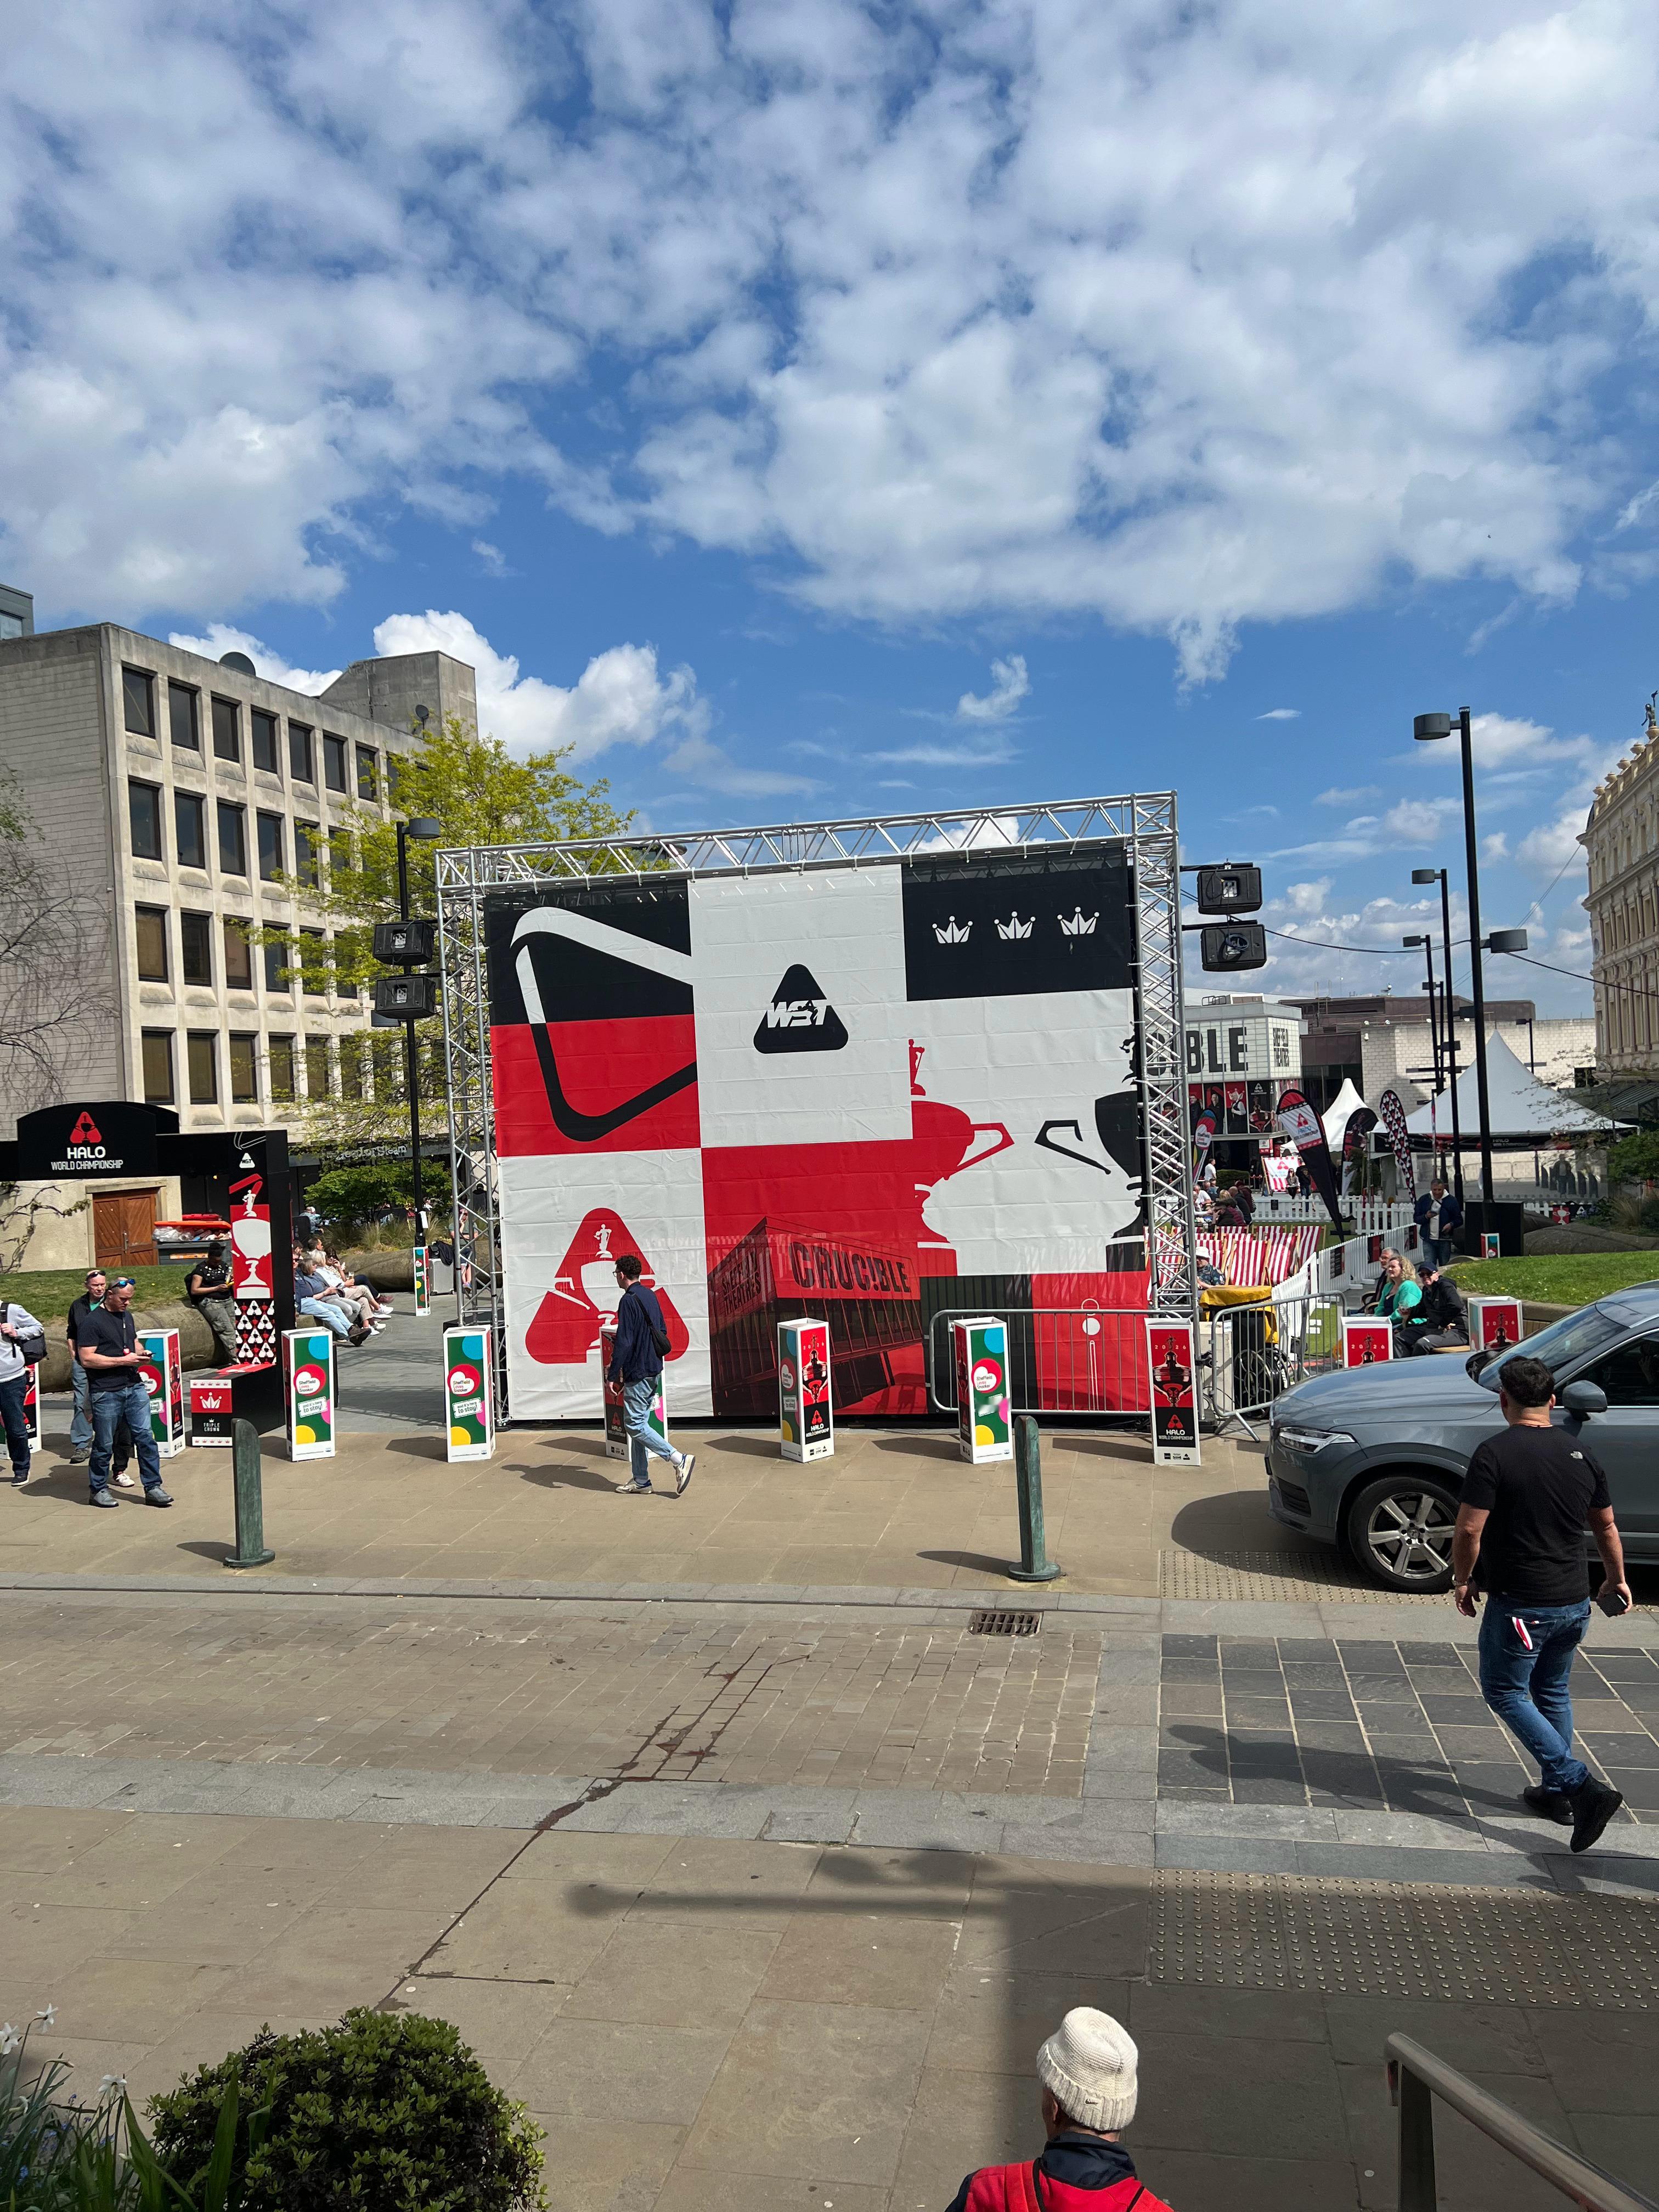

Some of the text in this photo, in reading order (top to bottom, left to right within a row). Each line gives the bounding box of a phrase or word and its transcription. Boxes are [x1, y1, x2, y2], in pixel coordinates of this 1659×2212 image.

[767, 999, 827, 1028] WST
[67, 1146, 106, 1159] HALO
[51, 1160, 123, 1170] WORLD CHAMPIONSHIP
[810, 1423, 824, 1432] HALO
